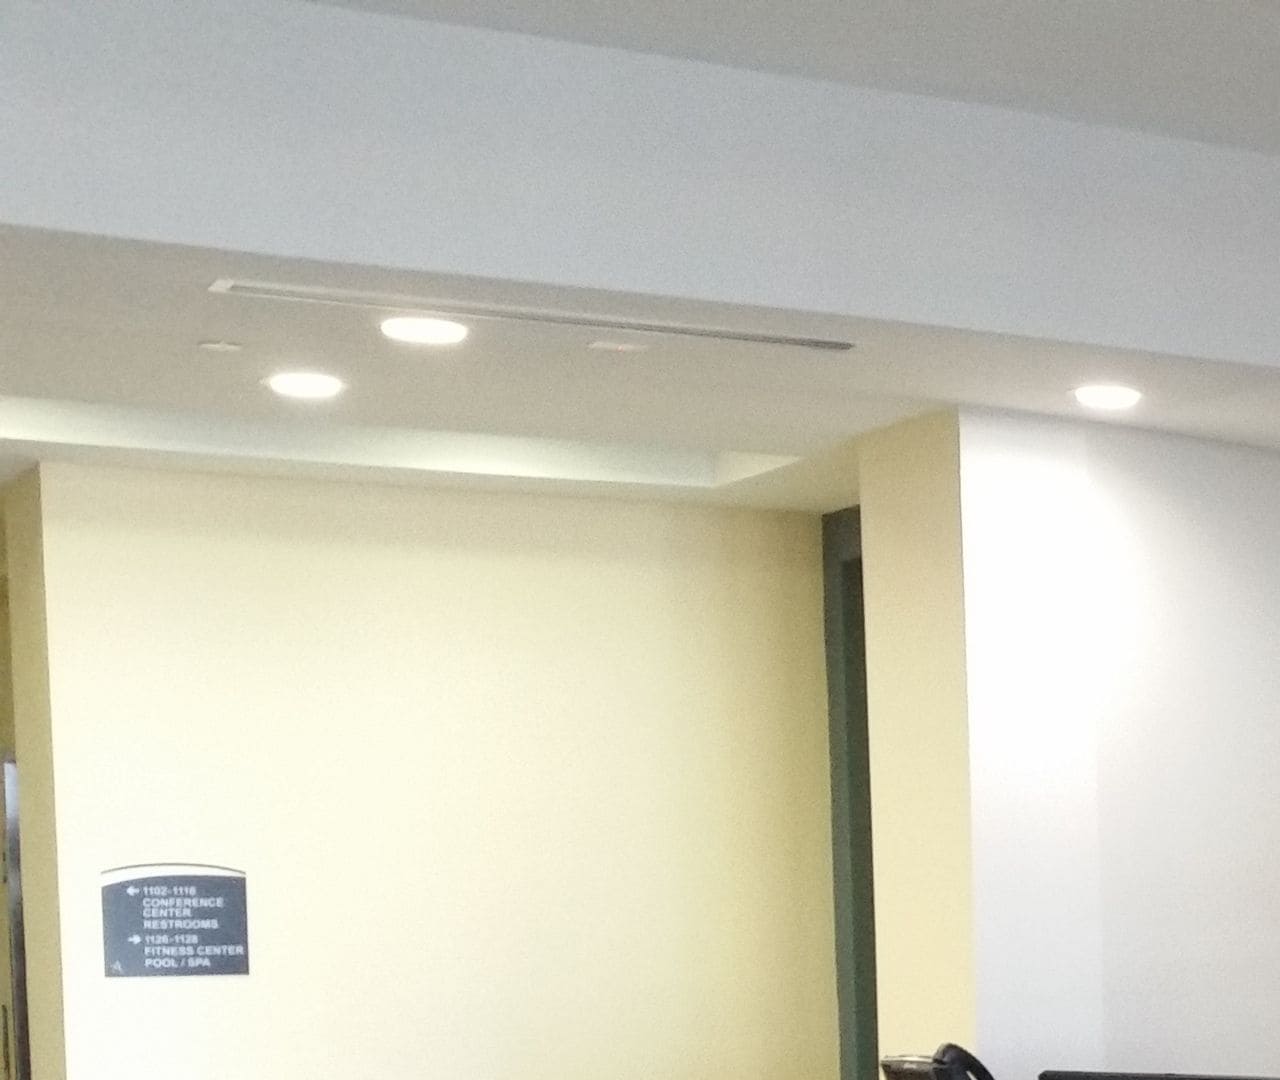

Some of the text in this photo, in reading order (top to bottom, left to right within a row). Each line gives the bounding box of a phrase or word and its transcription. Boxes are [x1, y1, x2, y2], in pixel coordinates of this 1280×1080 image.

[142, 897, 224, 908] CONFERENCE
[142, 908, 191, 918] CENTER
[143, 919, 219, 929] RESTROOMS
[144, 945, 244, 956] FITNESS CENTER
[144, 957, 178, 968] POOL
[187, 957, 211, 968] SPA
